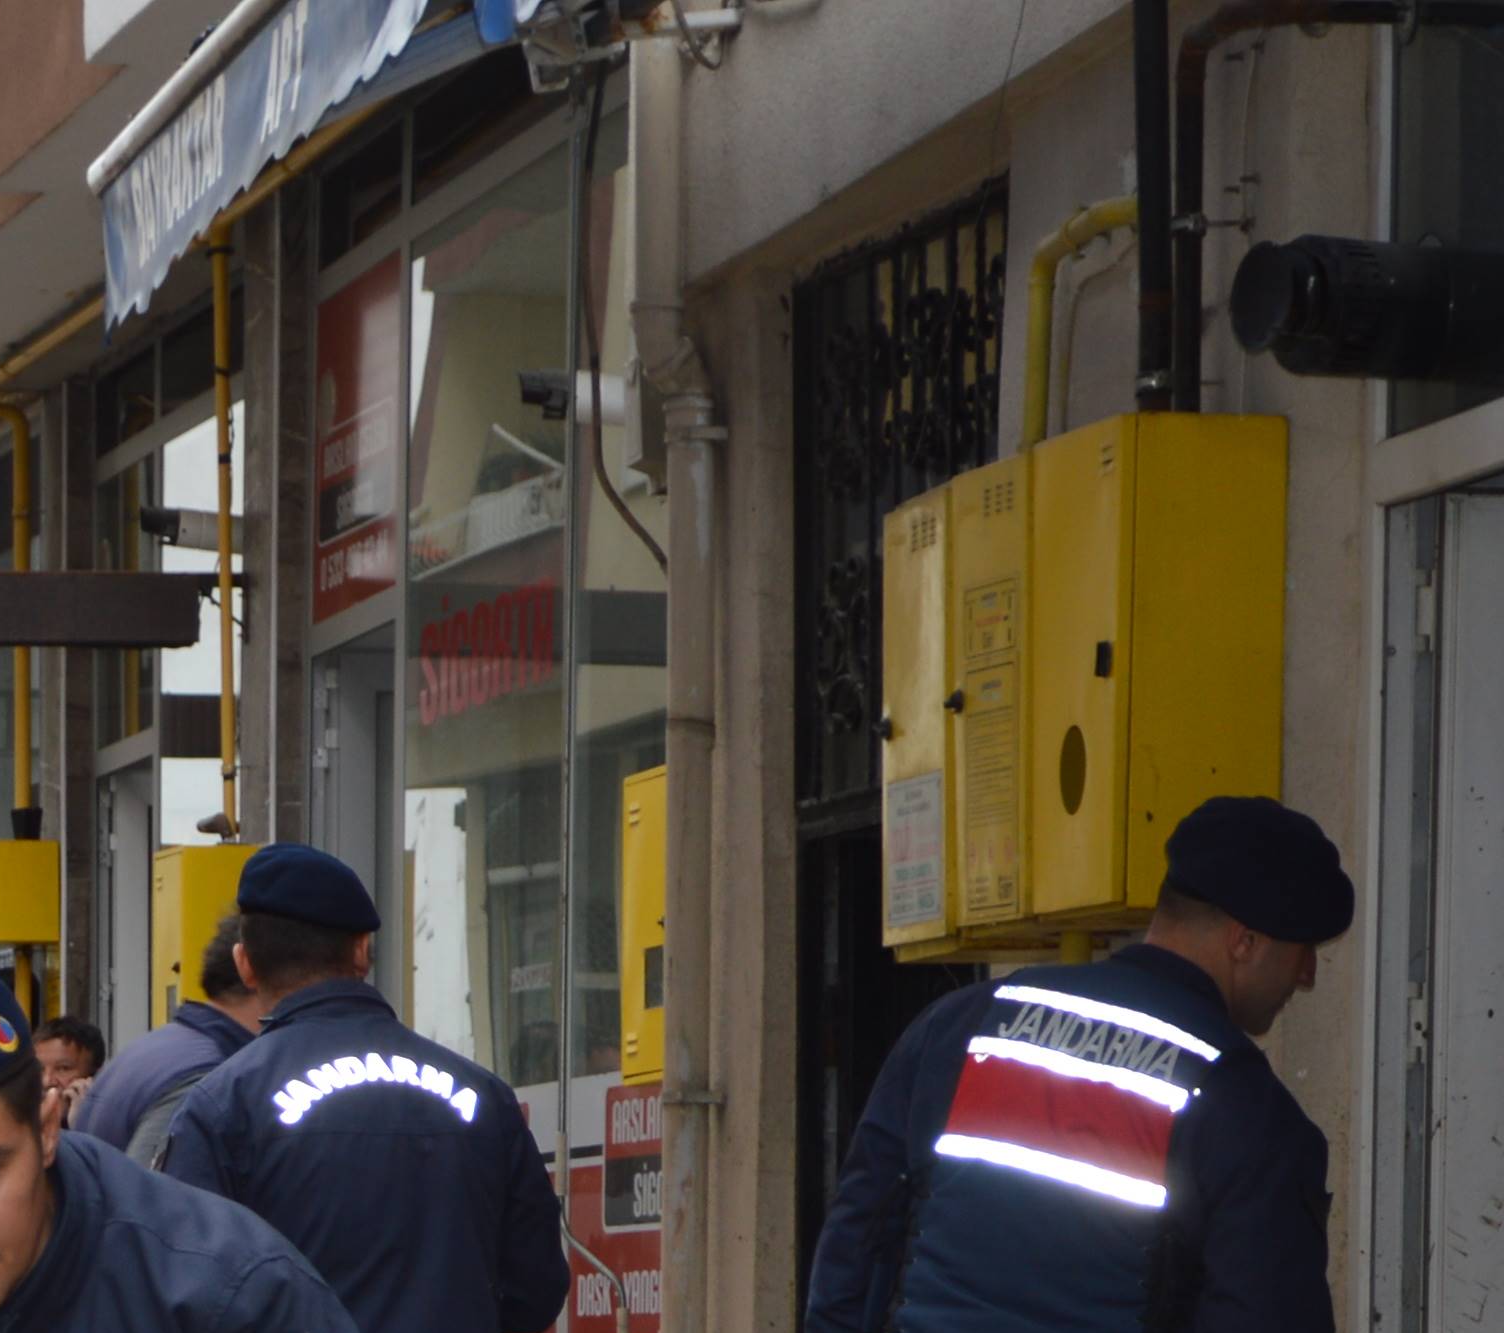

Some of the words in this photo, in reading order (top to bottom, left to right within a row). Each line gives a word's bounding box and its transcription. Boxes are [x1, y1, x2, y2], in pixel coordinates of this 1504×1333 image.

[420, 577, 555, 726] SİGORTA
[998, 1002, 1181, 1081] JANDARMA
[273, 1053, 478, 1124] JANDARMA
[577, 1272, 612, 1317] DASK
